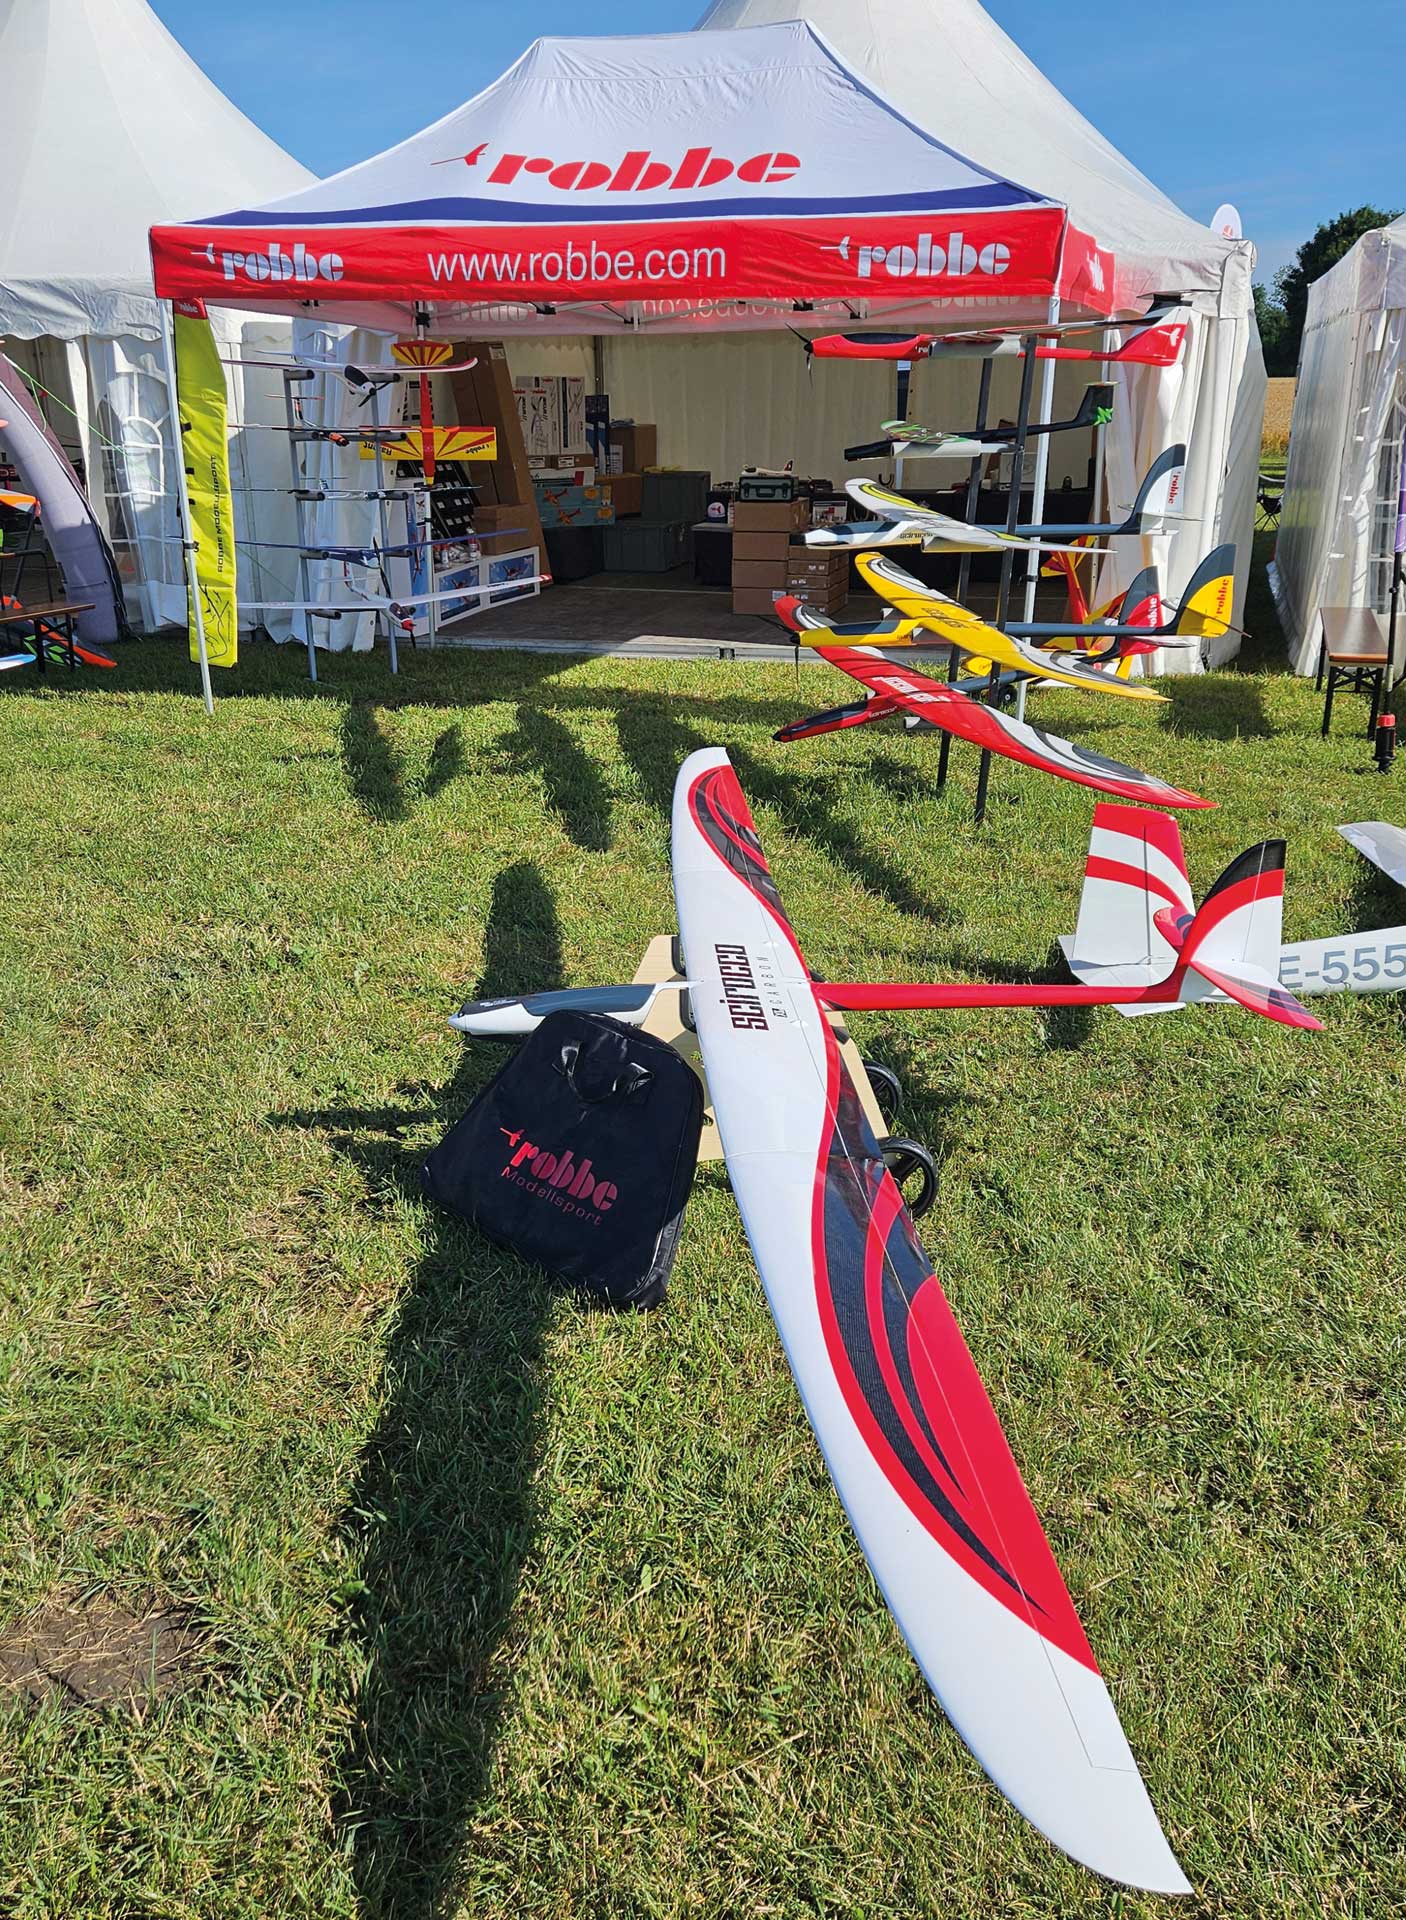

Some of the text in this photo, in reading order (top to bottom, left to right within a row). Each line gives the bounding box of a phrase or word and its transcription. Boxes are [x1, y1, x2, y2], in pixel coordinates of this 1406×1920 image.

[487, 147, 800, 191] robbe
[223, 243, 343, 281] robbe
[427, 240, 726, 282] www.robbe.com
[858, 232, 1011, 277] robbe
[1168, 474, 1179, 504] robbe
[1216, 579, 1230, 614] robbe
[715, 943, 769, 1031] scirocco
[756, 957, 783, 1004] CARBON
[501, 1166, 603, 1226] Modellsport
[510, 1141, 618, 1211] robbe
